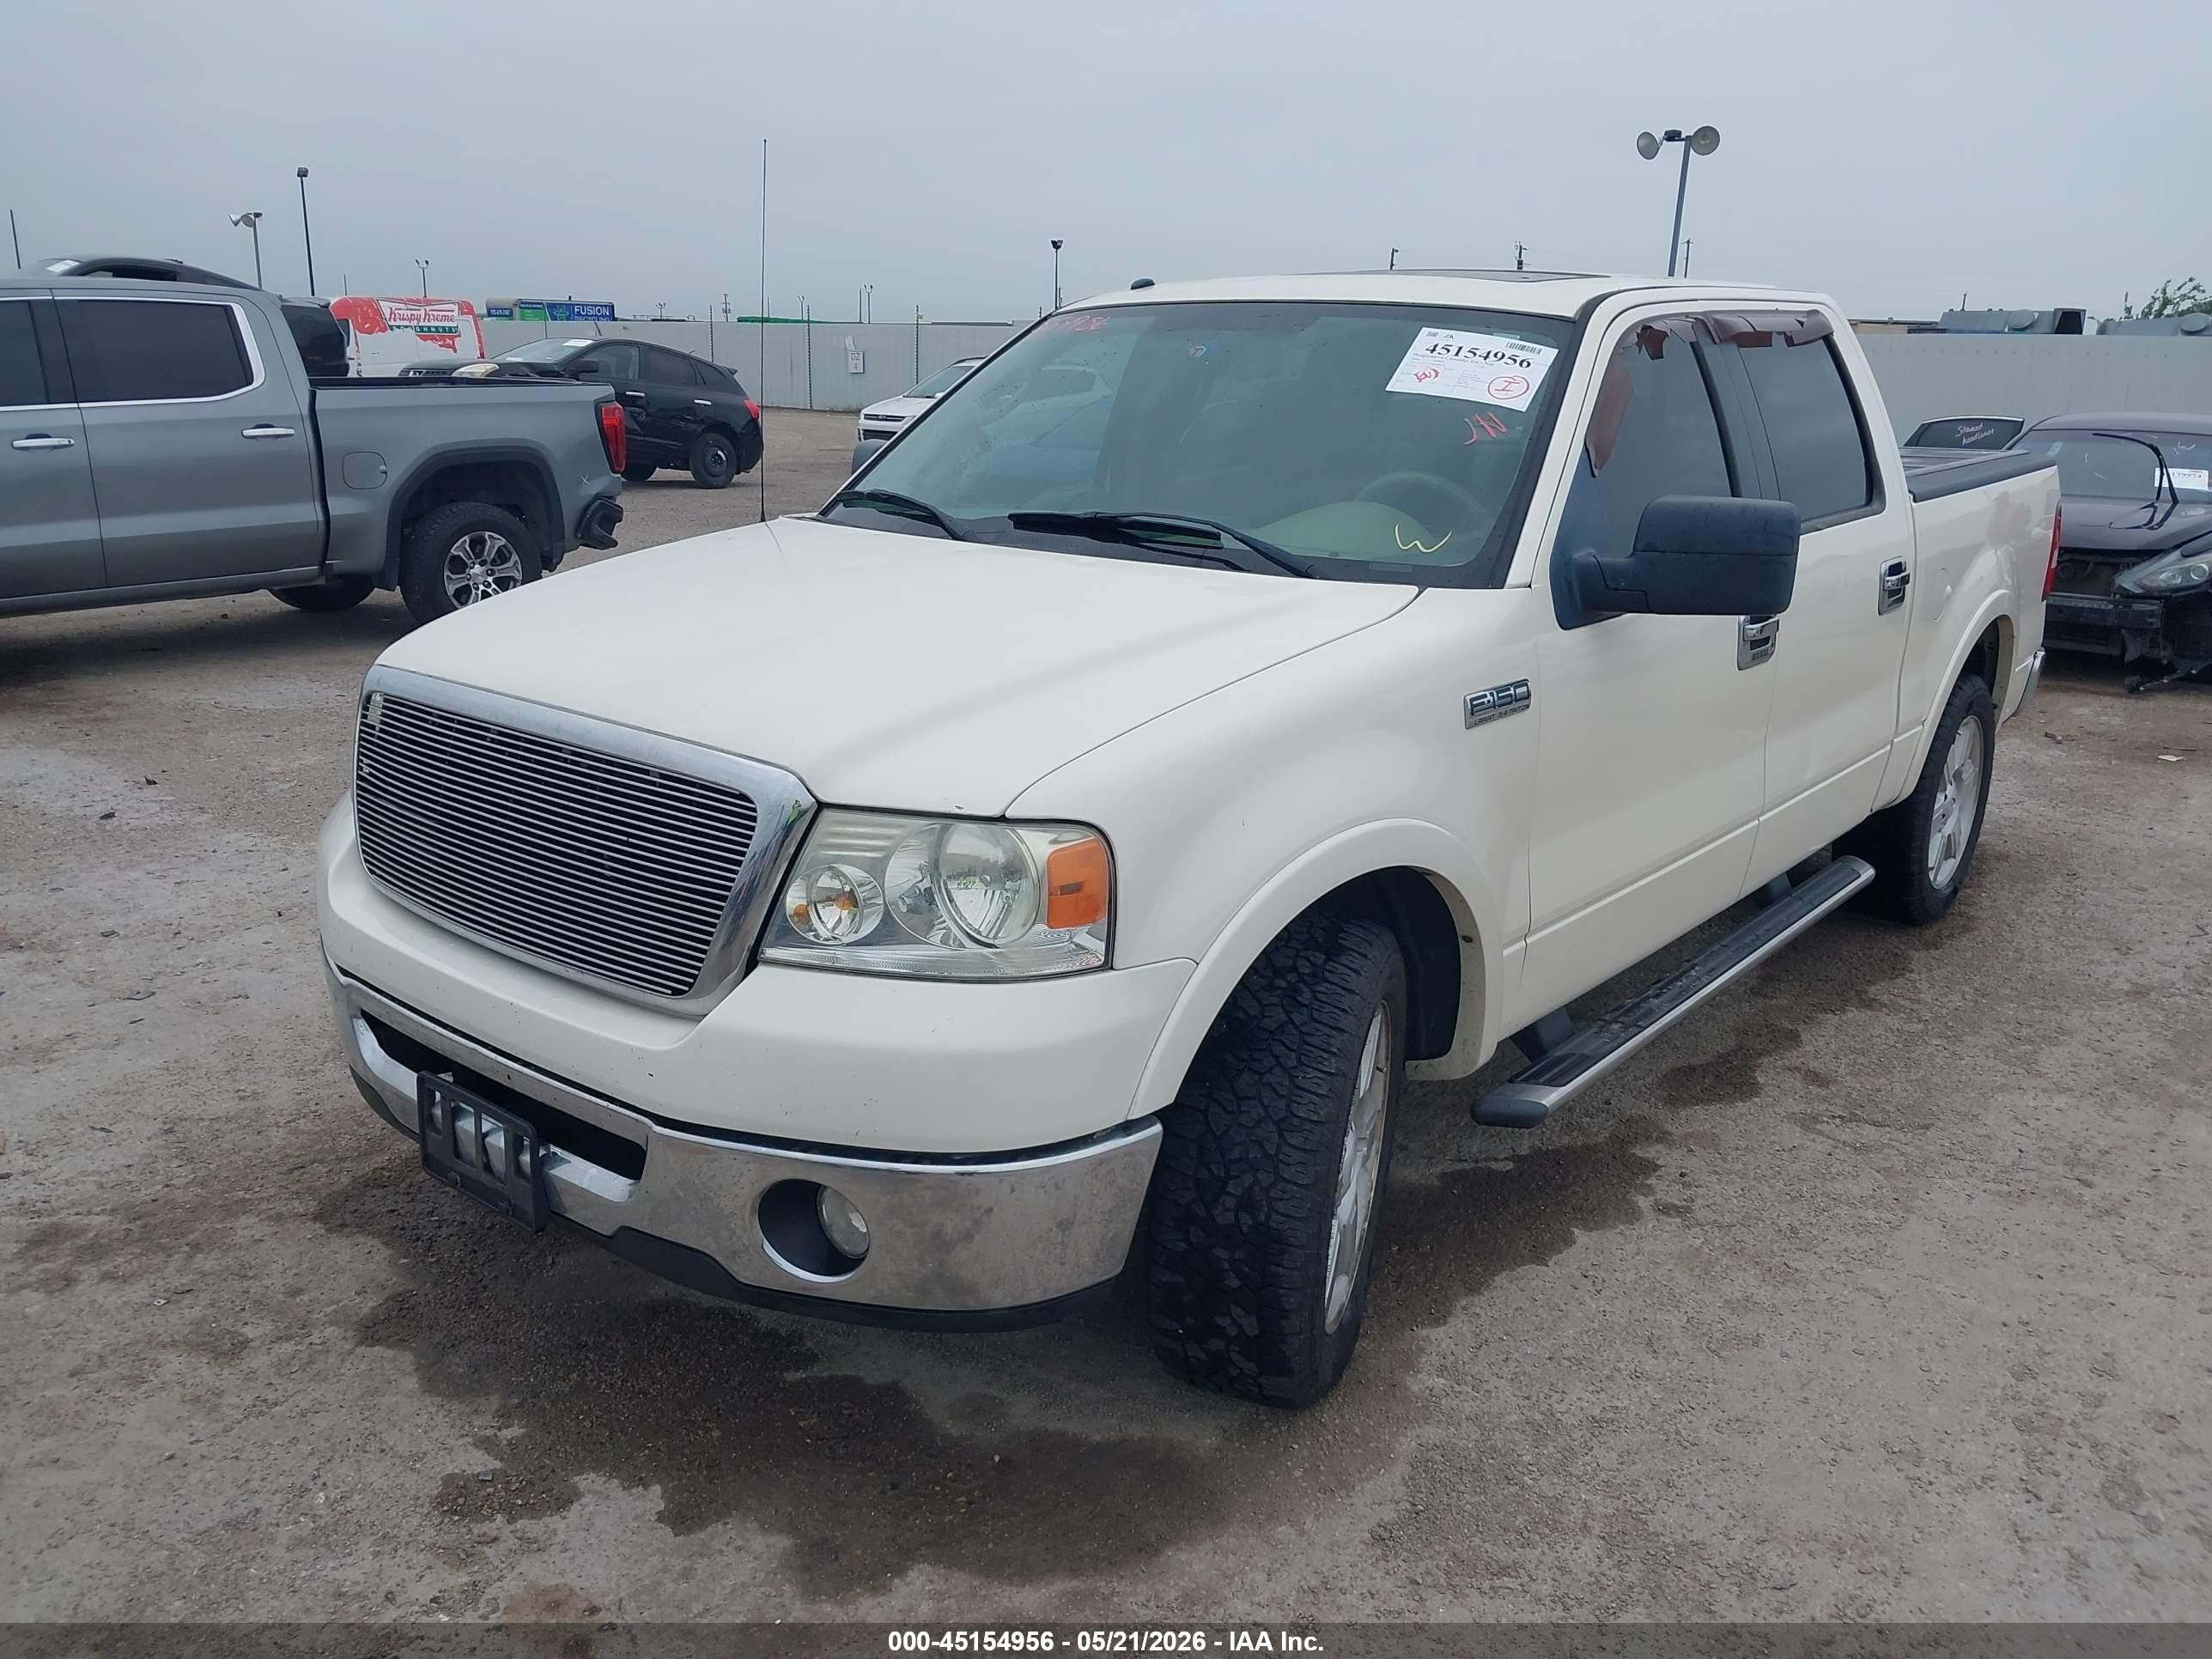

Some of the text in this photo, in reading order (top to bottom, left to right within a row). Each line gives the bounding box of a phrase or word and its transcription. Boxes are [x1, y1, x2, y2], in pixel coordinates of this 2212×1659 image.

[389, 307, 455, 325] Krispy Kreme
[574, 305, 610, 316] FUSION
[1425, 343, 1532, 369] 45154956
